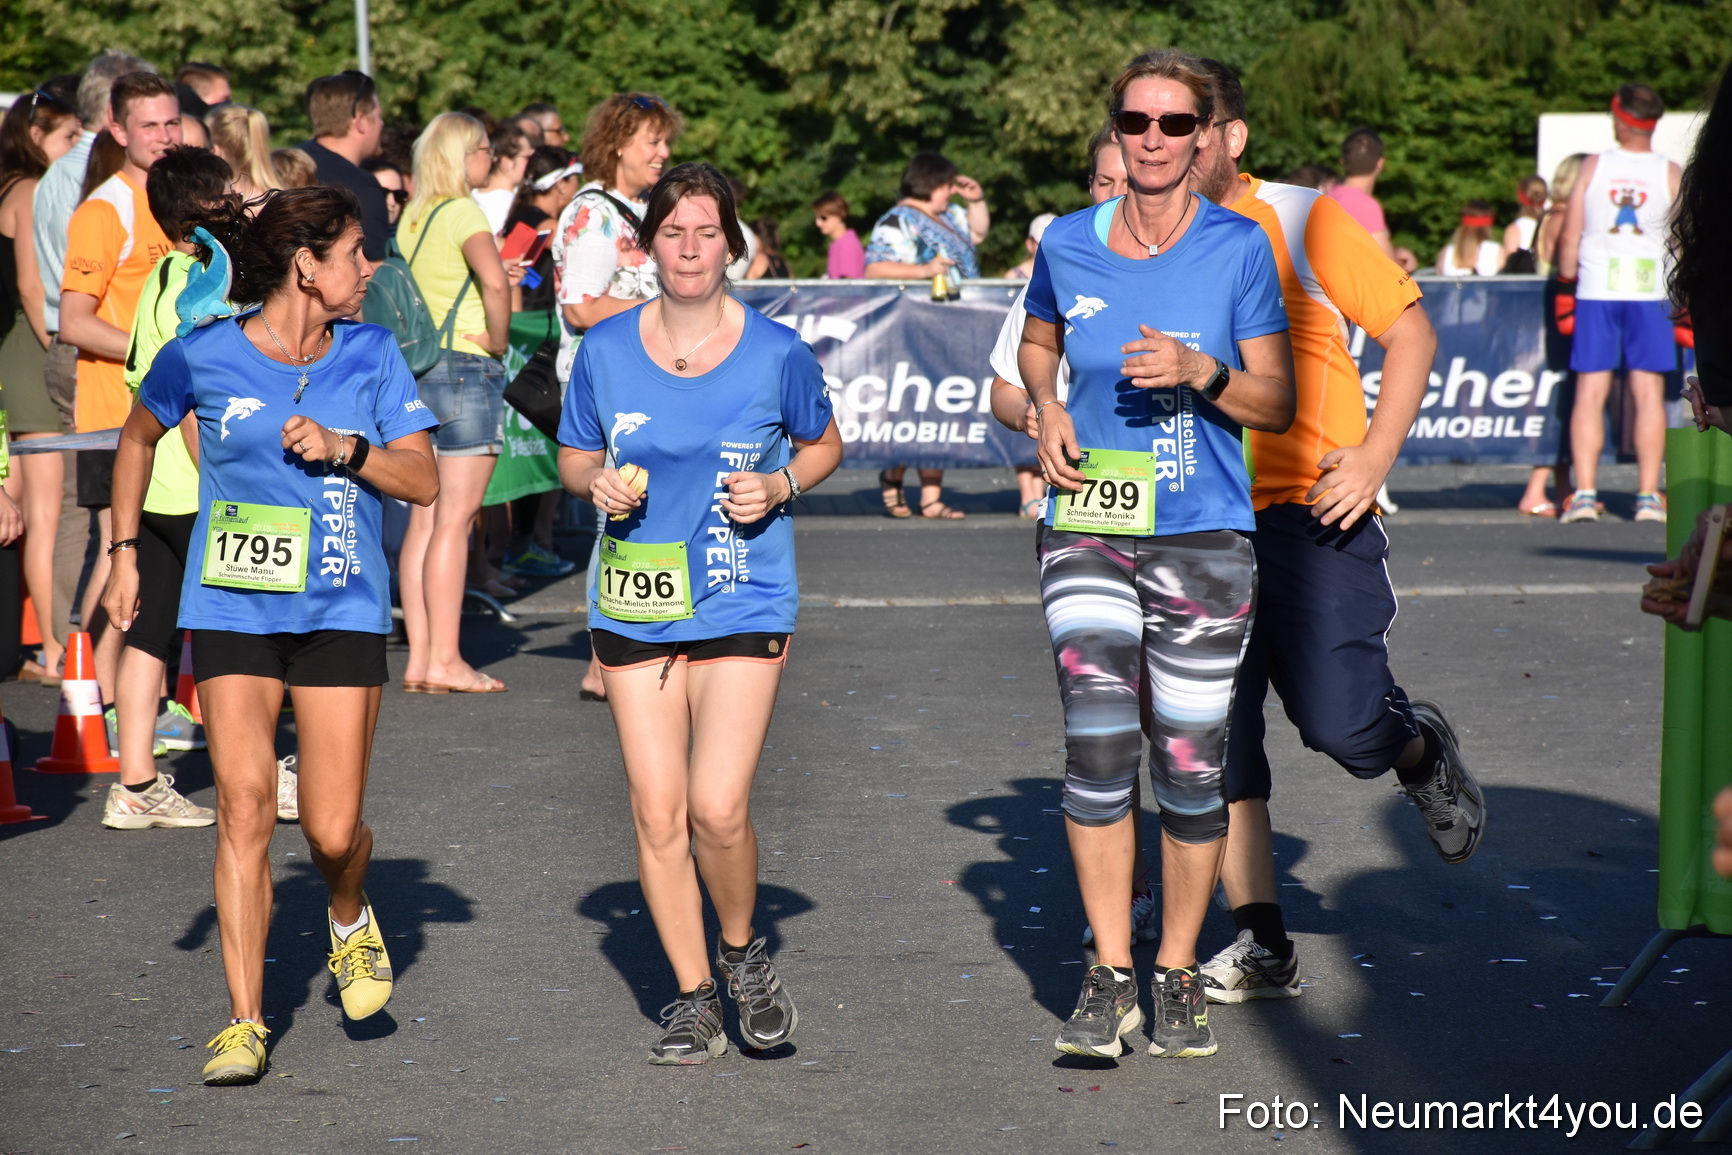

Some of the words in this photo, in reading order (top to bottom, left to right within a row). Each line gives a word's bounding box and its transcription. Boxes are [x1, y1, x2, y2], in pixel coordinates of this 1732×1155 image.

[721, 441, 753, 449] POWERED
[1066, 508, 1102, 519] Schneider
[1104, 511, 1135, 520] Monika
[1068, 517, 1109, 526] Schwimmschule
[216, 531, 292, 567] 1795
[225, 563, 249, 572] Stüwe
[250, 566, 274, 575] Manu
[218, 571, 260, 581] Schwimmschule
[604, 565, 675, 600] 1796
[608, 605, 647, 614] Schwimmschule
[648, 607, 668, 615] Flipper
